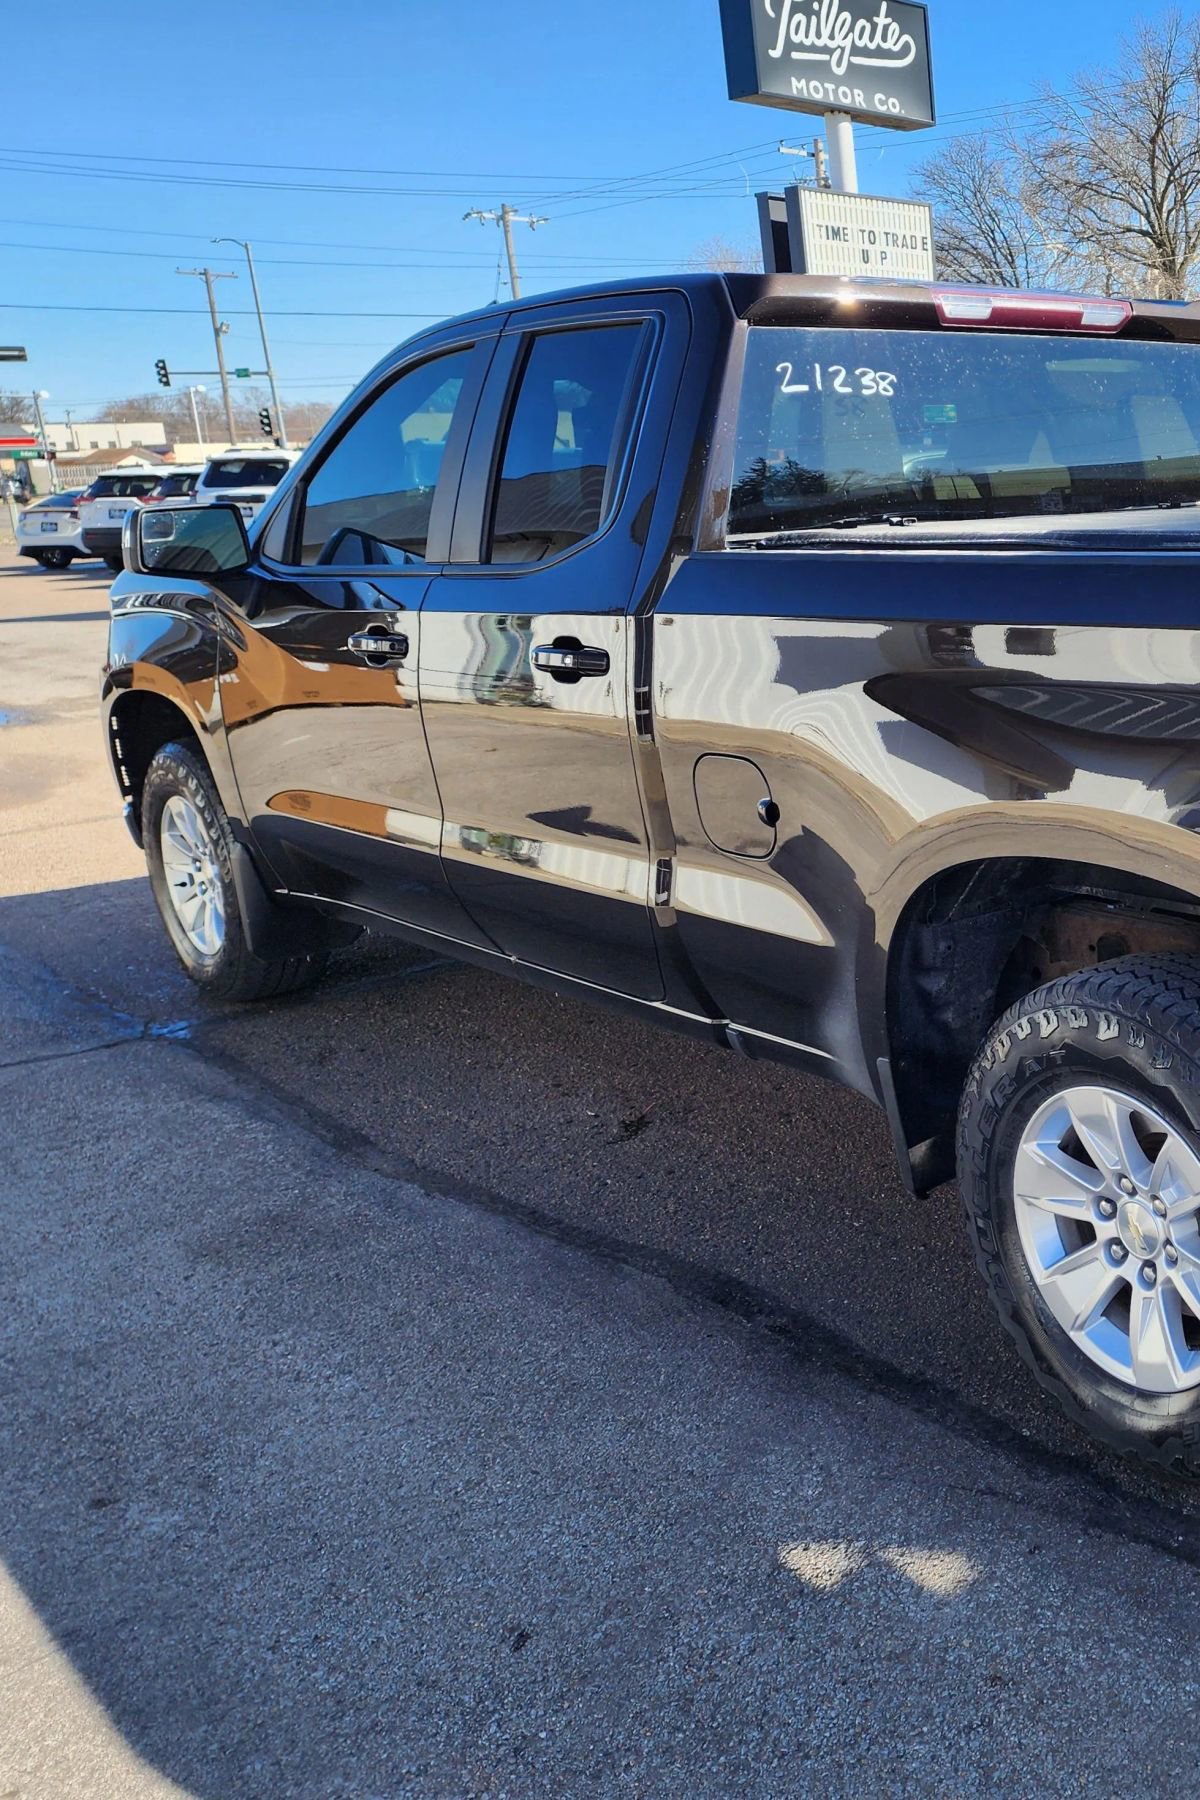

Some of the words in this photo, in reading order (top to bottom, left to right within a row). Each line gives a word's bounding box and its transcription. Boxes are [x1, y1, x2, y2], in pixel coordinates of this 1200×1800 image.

[765, 0, 917, 76] Tailgate
[790, 76, 867, 108] MOTOR
[873, 92, 906, 114] CO.
[816, 224, 850, 243] TIME
[858, 228, 877, 246] TO
[883, 231, 929, 252] TRADE
[775, 362, 898, 396] 21238
